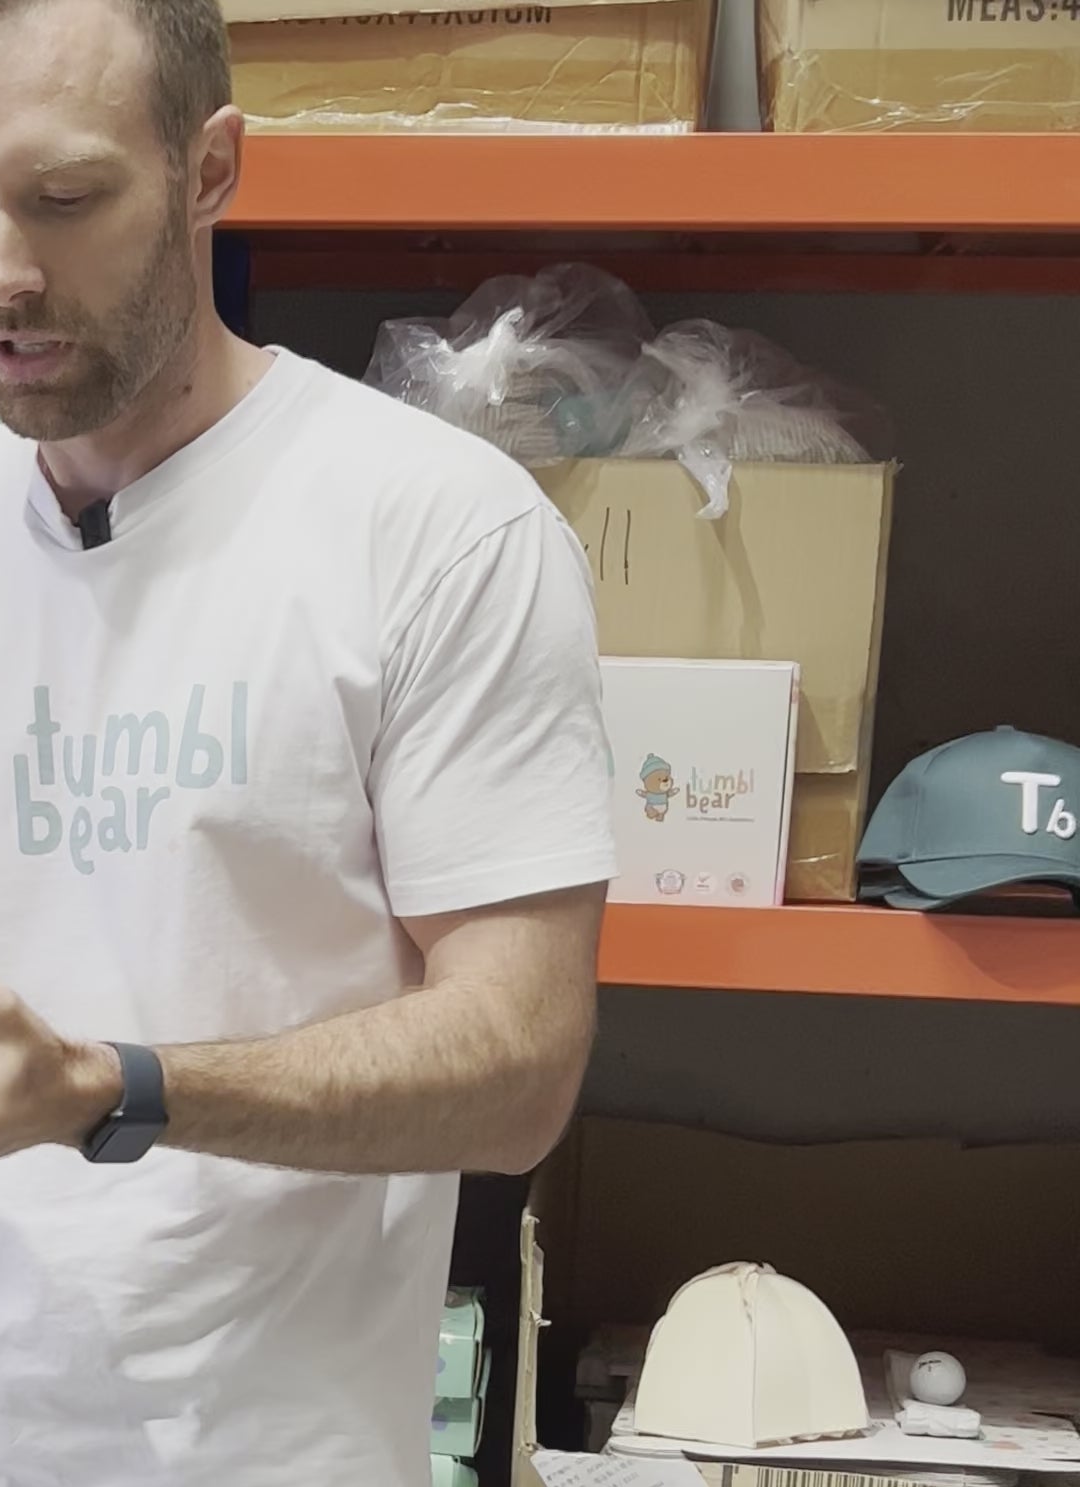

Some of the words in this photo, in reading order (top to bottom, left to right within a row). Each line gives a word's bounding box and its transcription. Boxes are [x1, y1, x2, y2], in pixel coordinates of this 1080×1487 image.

[26, 681, 248, 797] tumbl
[13, 753, 171, 875] bear
[685, 783, 736, 814] bear
